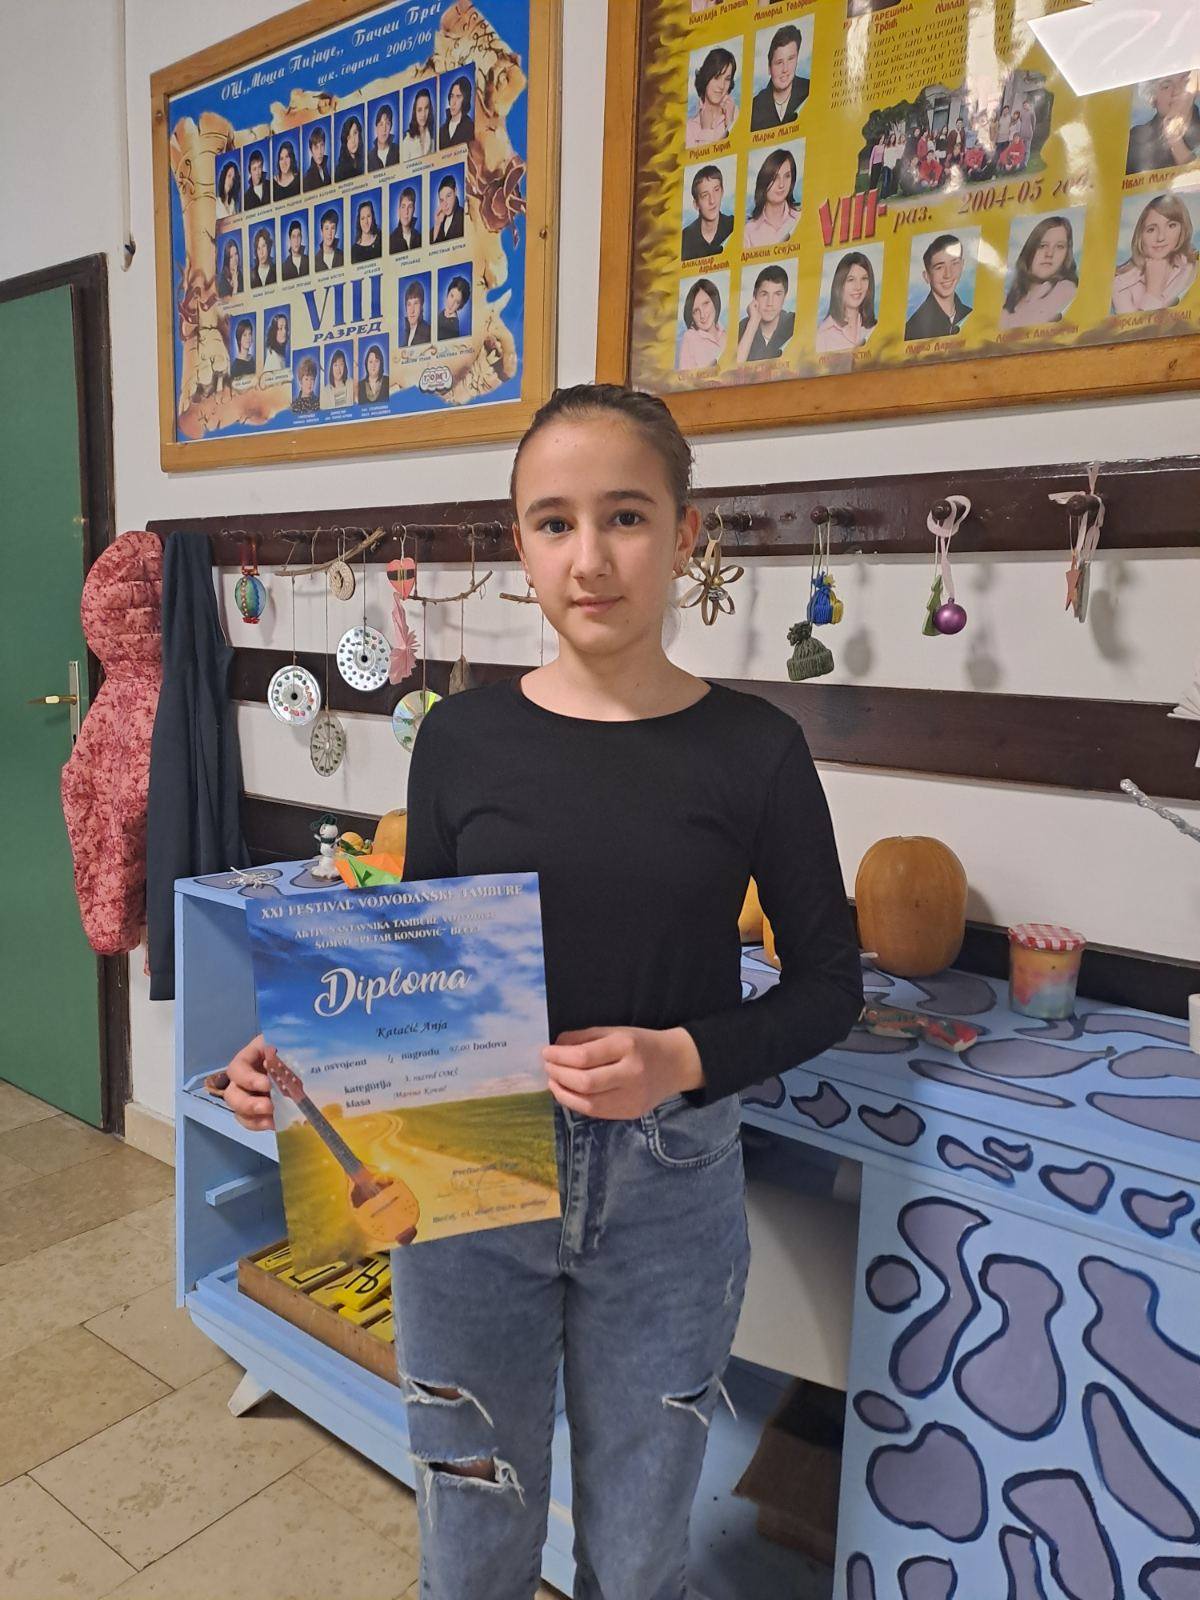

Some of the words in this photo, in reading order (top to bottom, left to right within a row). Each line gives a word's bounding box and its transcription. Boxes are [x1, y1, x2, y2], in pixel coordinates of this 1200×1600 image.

[352, 19, 400, 47] Бачки
[386, 30, 432, 58] 2005/06
[958, 179, 1045, 215] 2004-05
[302, 273, 383, 331] VIII
[313, 321, 382, 343] РАЗРЕД
[261, 907, 283, 920] XXI
[288, 899, 354, 917] FESTIVAL
[460, 884, 524, 898] TAMBURE
[313, 967, 473, 1018] Diploma
[420, 1020, 448, 1034] Anja
[401, 1048, 440, 1062] nagradu
[473, 1040, 507, 1052] bodova
